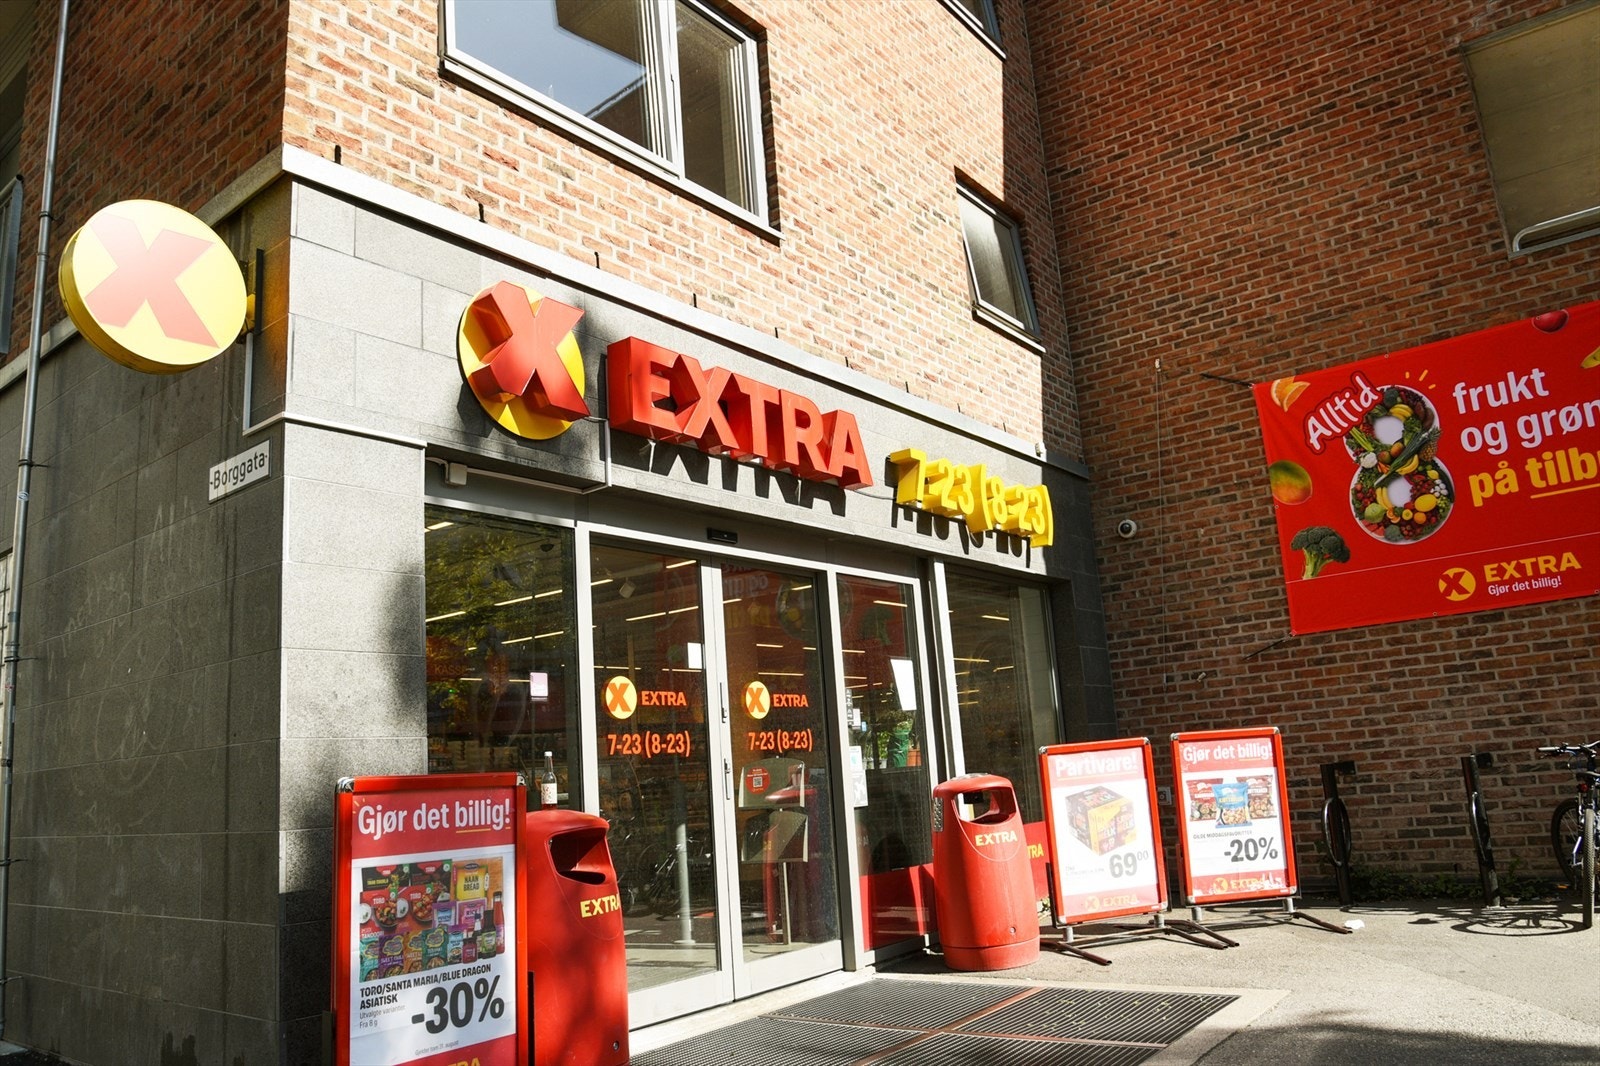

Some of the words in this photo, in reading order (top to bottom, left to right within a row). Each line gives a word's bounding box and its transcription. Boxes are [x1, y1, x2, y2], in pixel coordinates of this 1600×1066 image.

[1452, 367, 1550, 415] frukt
[607, 336, 873, 490] EXTRA
[1306, 376, 1379, 450] Alltid
[1460, 420, 1509, 456] og
[213, 452, 265, 489] Borggata
[1468, 460, 1520, 508] på
[1525, 447, 1600, 488] tilb
[889, 447, 974, 517] 7-23
[965, 462, 1054, 549] (8-23)
[1483, 552, 1582, 583] EXTRA
[1487, 584, 1510, 596] Gjør
[1512, 580, 1530, 592] det
[1532, 576, 1562, 589] billig!
[641, 691, 687, 706] EXTRA
[773, 693, 809, 708] EXTRA
[607, 733, 642, 755] 7-23
[645, 730, 691, 758] (8-23)
[748, 731, 775, 751] 7-23
[777, 728, 813, 753] (8-23)
[1183, 746, 1210, 764] Gjør
[1214, 745, 1236, 760] det
[1238, 743, 1273, 760] billig!
[1055, 752, 1138, 778] Partivare!
[357, 805, 407, 841] Gjør
[413, 803, 450, 831] det
[455, 798, 511, 831] billig!
[975, 830, 1018, 847] EXTRA
[1027, 843, 1045, 859] TRA
[1224, 837, 1278, 862] -20%
[1103, 894, 1139, 907] EXTRA
[360, 981, 412, 998] TORO/SANTA
[413, 971, 461, 987] MARIA/BLUE
[462, 964, 492, 978] DRAGON
[360, 994, 398, 1010] ASIATISK
[360, 1009, 382, 1020] Utvalgte
[411, 975, 504, 1034] -30%
[359, 1020, 368, 1029] Fra
[374, 1019, 378, 1027] g
